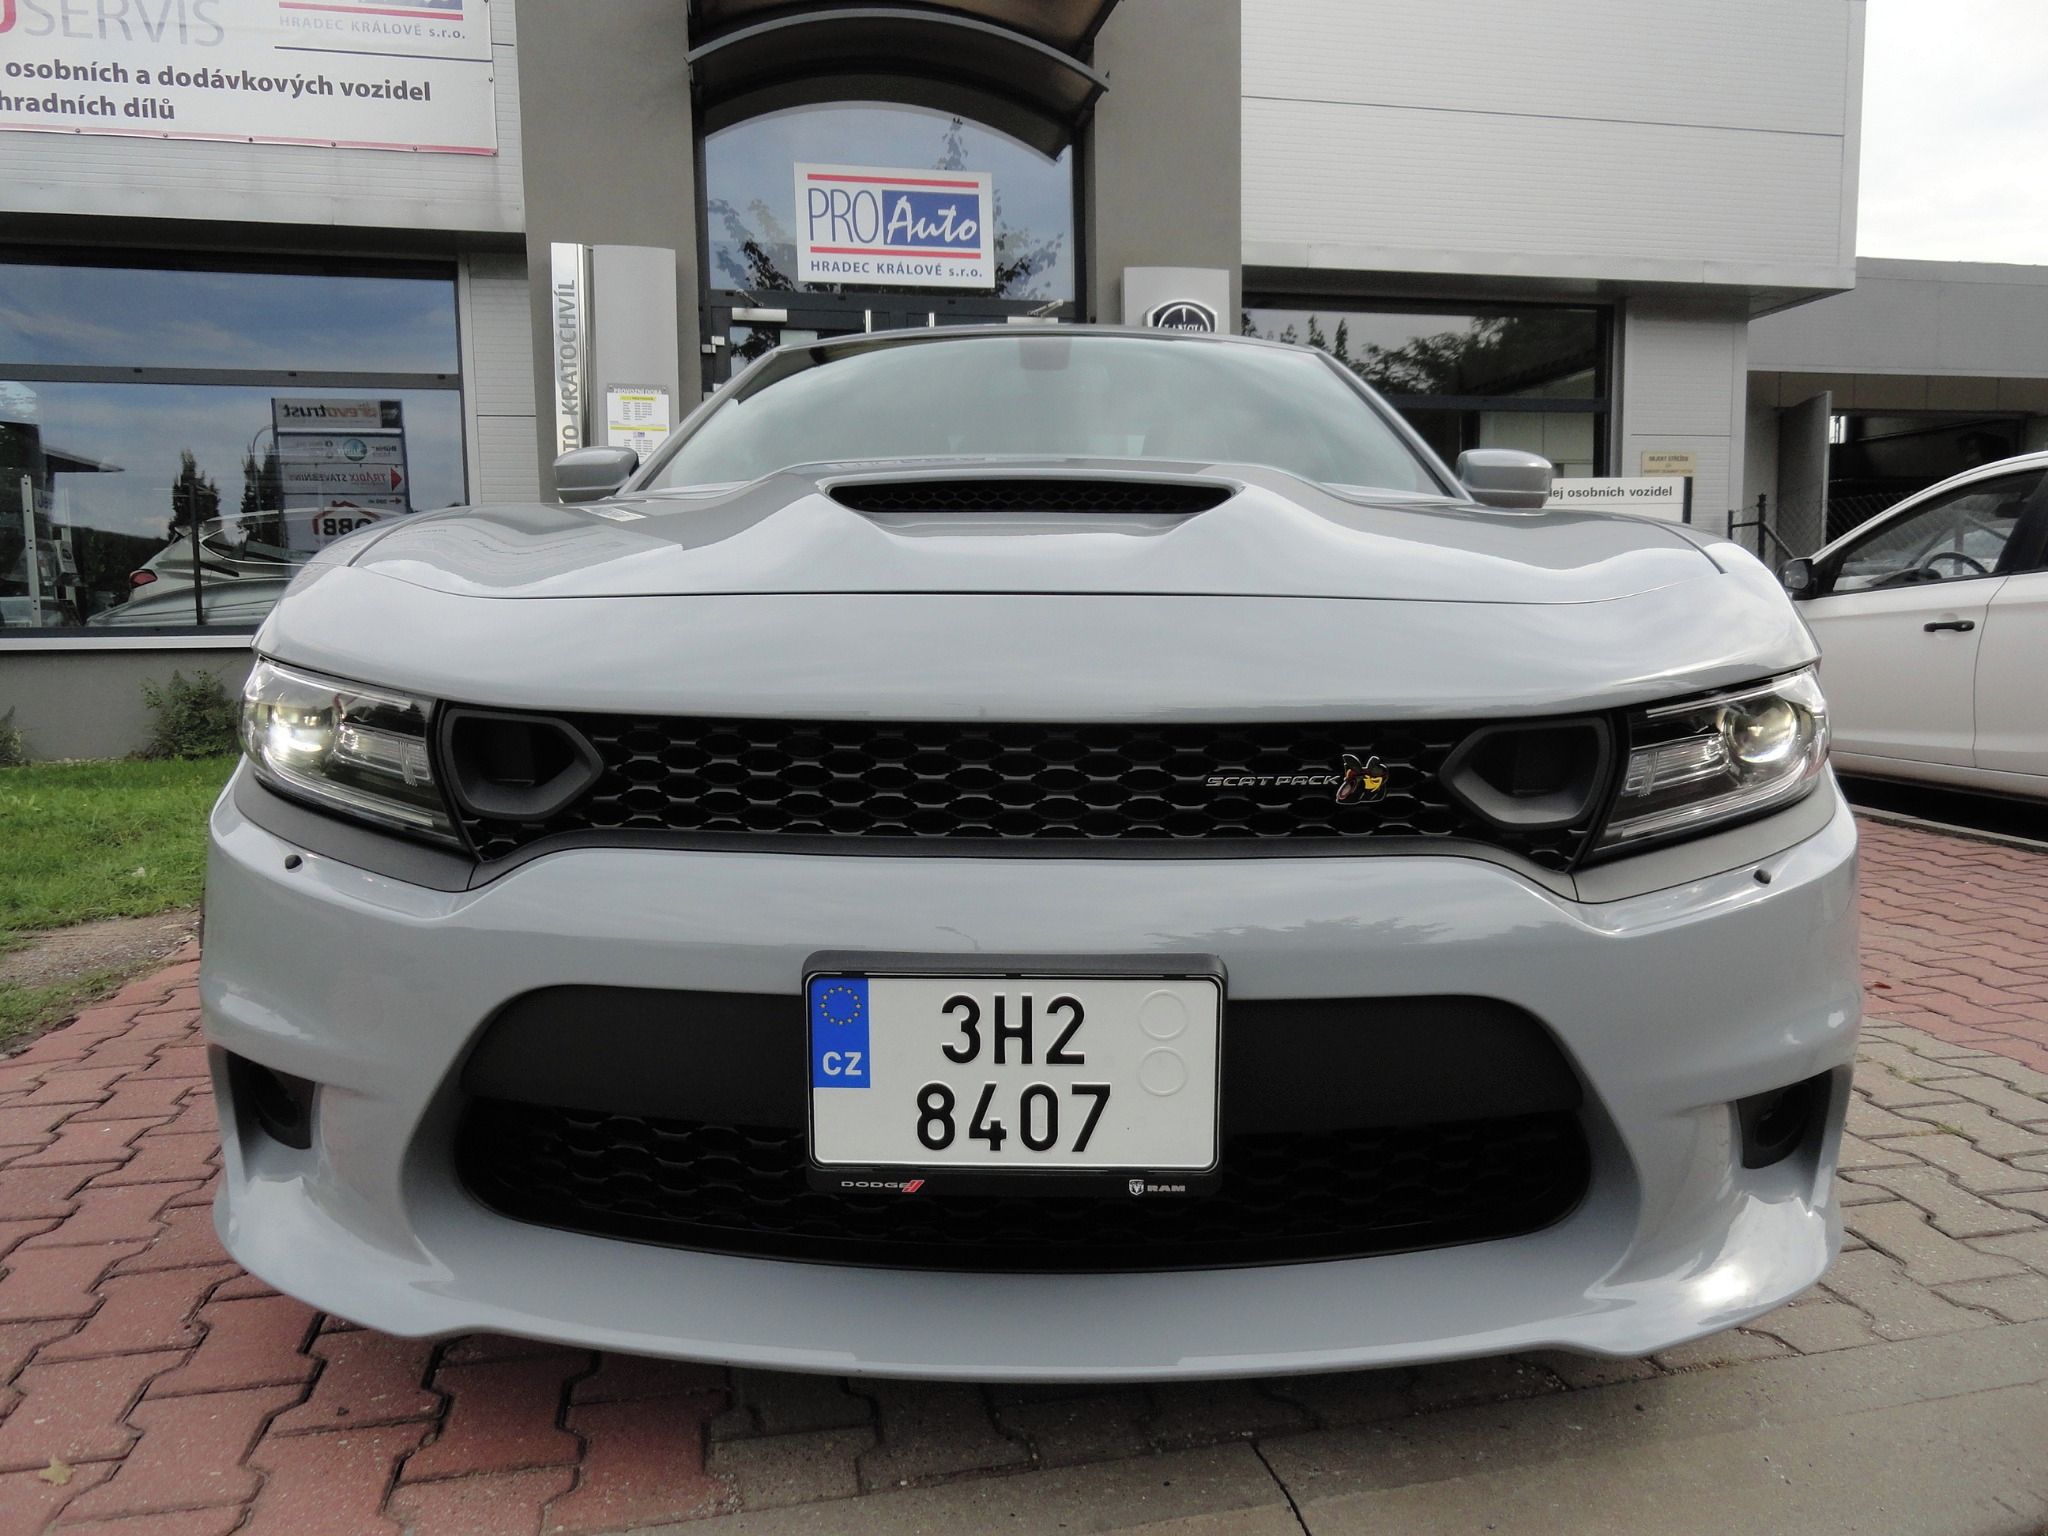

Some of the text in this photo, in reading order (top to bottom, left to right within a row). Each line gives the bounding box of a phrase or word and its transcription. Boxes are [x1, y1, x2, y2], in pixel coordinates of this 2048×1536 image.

[279, 15, 466, 39] HRADEC KRÁLOVÉ s.r.o.
[5, 59, 431, 101] osobních a dodávkových vozidel
[123, 97, 175, 119] dílů
[807, 188, 978, 245] PRO Auto
[811, 260, 983, 278] HRADEC KRÁLOVÉ s.r.o.
[554, 279, 579, 416] KRATOCHVÍL
[1567, 486, 1625, 498] osobních
[1629, 486, 1672, 497] vozidel
[1205, 775, 1341, 787] SCAT PACK
[941, 994, 1085, 1065] 3H2
[821, 1051, 863, 1076] CZ
[916, 1081, 1111, 1153] 8407
[841, 1181, 911, 1189] DODGE
